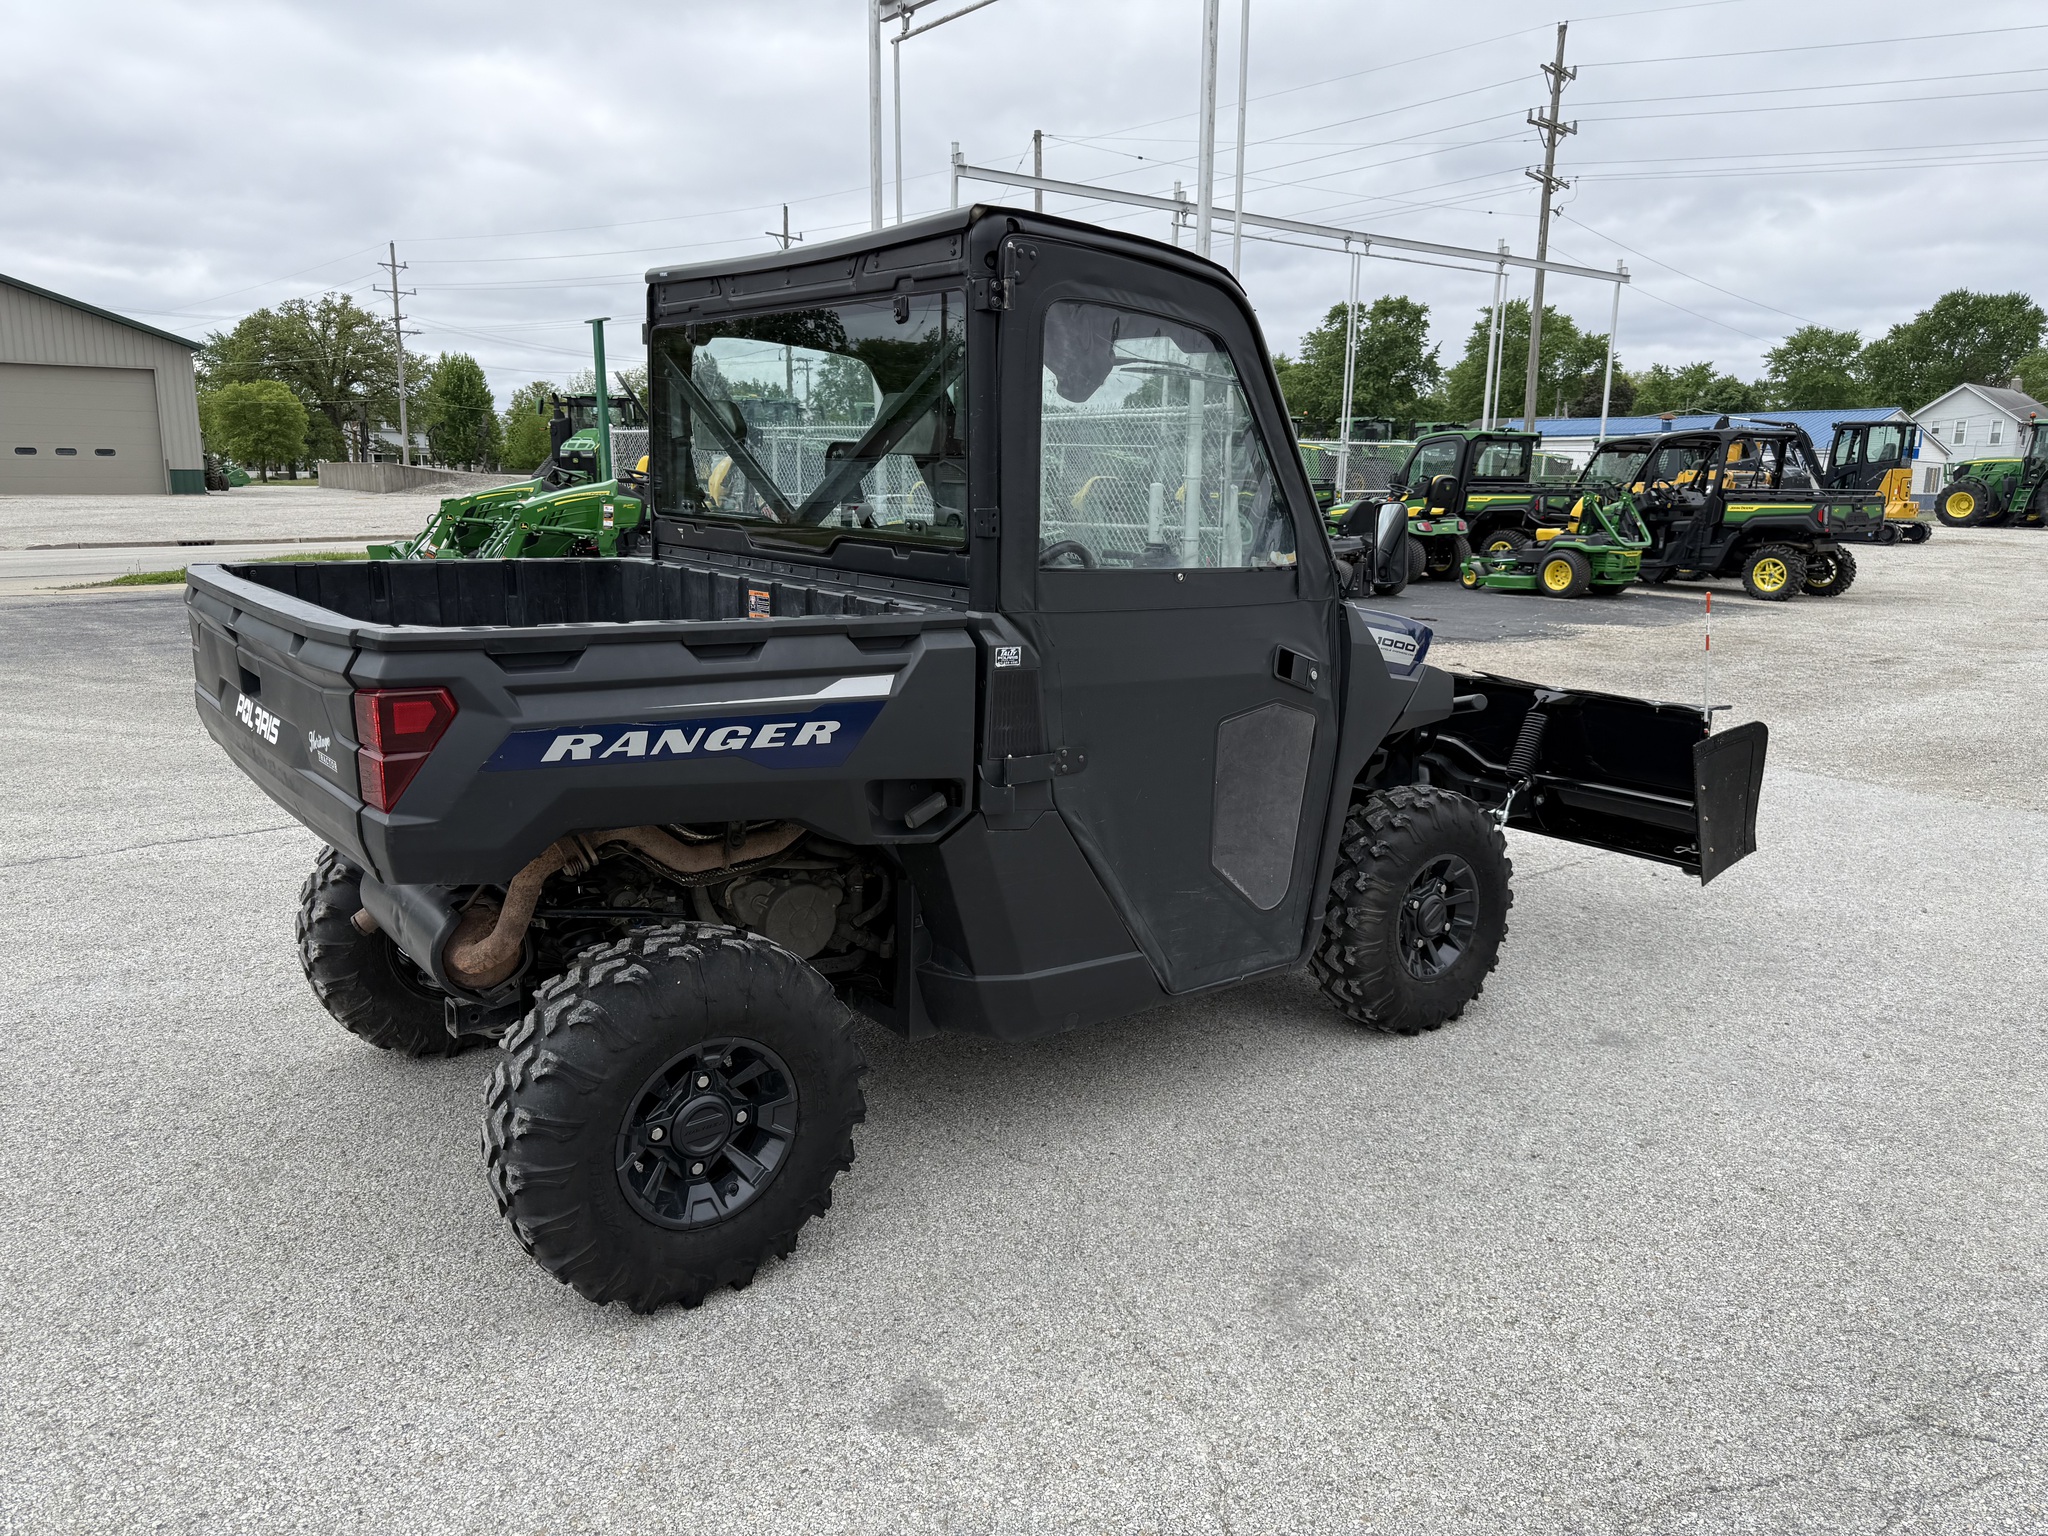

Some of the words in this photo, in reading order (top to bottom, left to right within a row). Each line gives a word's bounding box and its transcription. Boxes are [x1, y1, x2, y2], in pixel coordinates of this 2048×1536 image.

[1377, 636, 1416, 652] 1000
[236, 693, 281, 746] POLARIS
[540, 720, 841, 763] RANGER
[319, 751, 337, 773] TRACTOR
